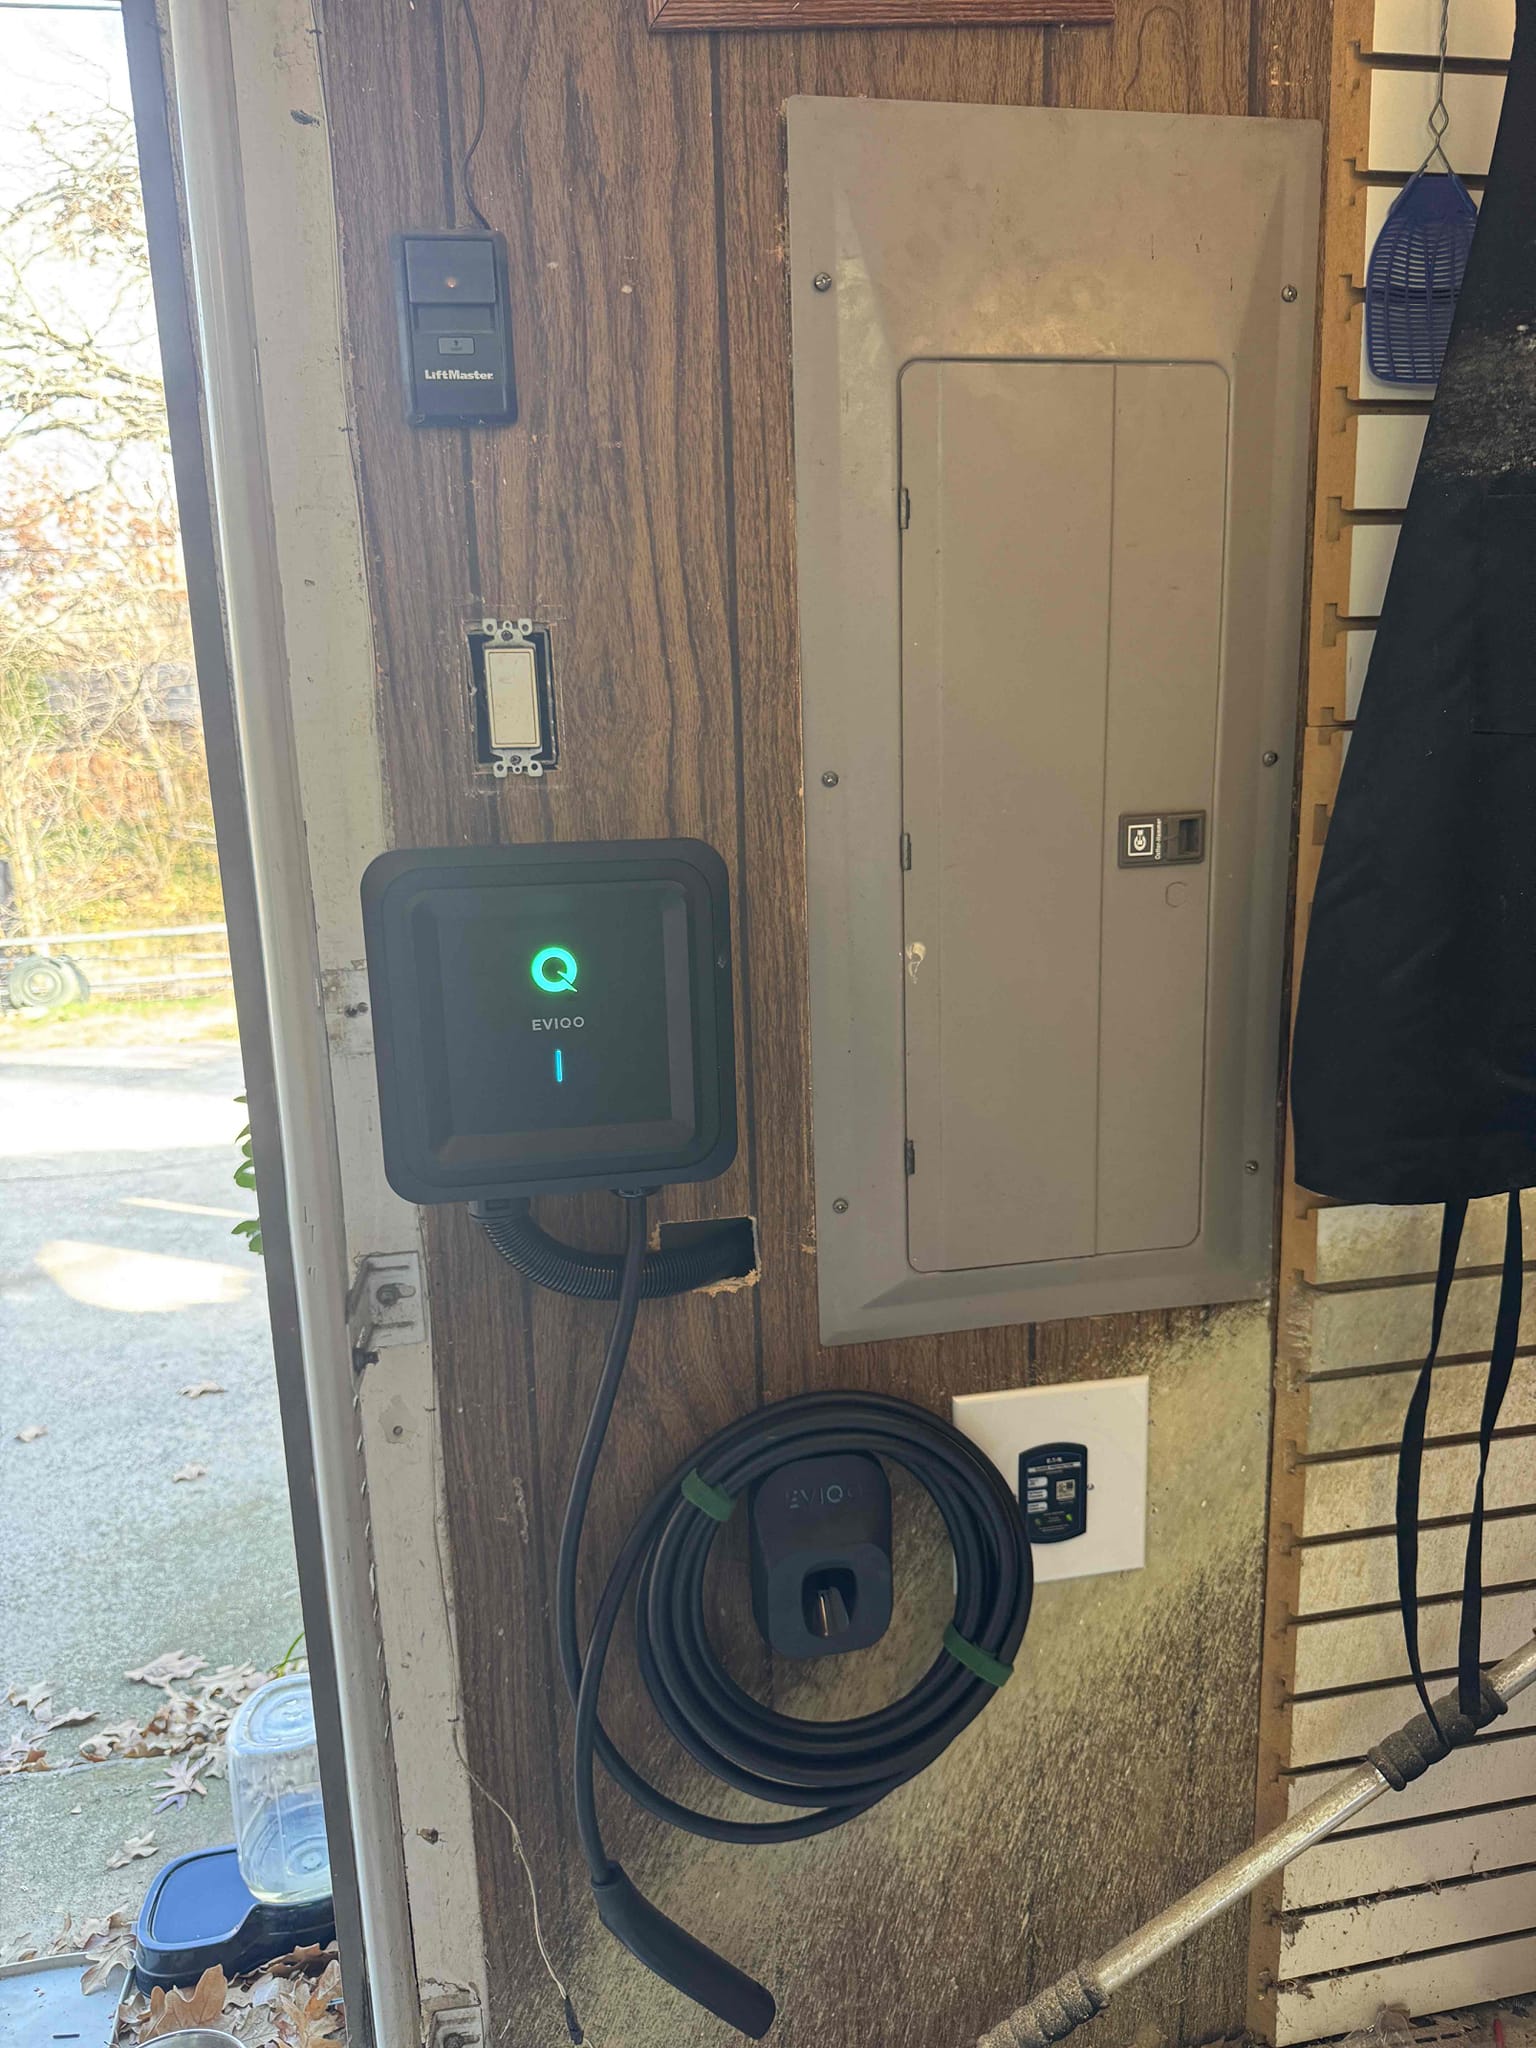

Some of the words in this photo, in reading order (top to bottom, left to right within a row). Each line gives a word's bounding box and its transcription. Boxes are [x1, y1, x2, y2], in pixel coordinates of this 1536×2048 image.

[424, 369, 495, 380] LiftMaster
[531, 947, 578, 993] Q
[531, 1016, 585, 1031] EVIQO
